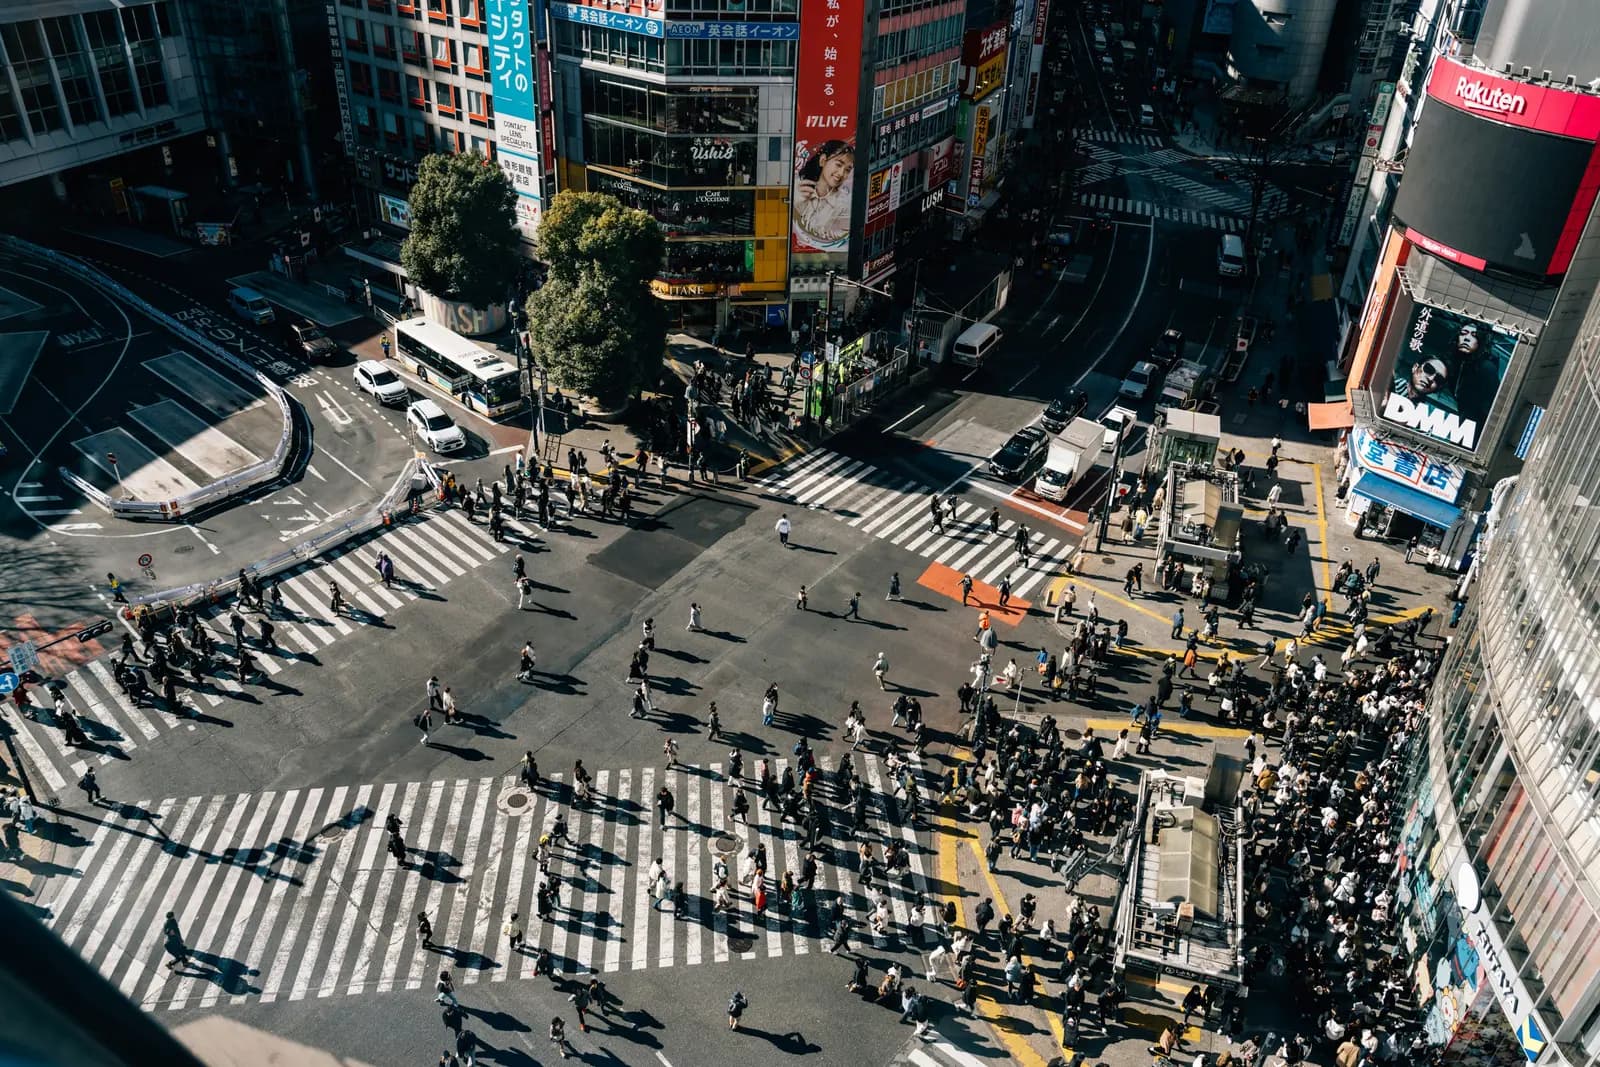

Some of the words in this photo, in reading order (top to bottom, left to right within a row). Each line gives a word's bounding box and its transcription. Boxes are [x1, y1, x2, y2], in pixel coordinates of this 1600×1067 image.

[580, 9, 643, 31] 英会話イーオン
[671, 24, 700, 34] AEON
[708, 23, 796, 38] 英会話イーオン
[1455, 76, 1526, 115] Rakuten
[503, 120, 527, 132] CONTACT
[806, 115, 849, 128] 17LIVE
[509, 130, 522, 139] LENS
[500, 135, 533, 150] SPECIALISTS
[921, 187, 944, 213] LUSH
[1408, 306, 1433, 354] 外道の歌
[1382, 392, 1477, 450] DMM
